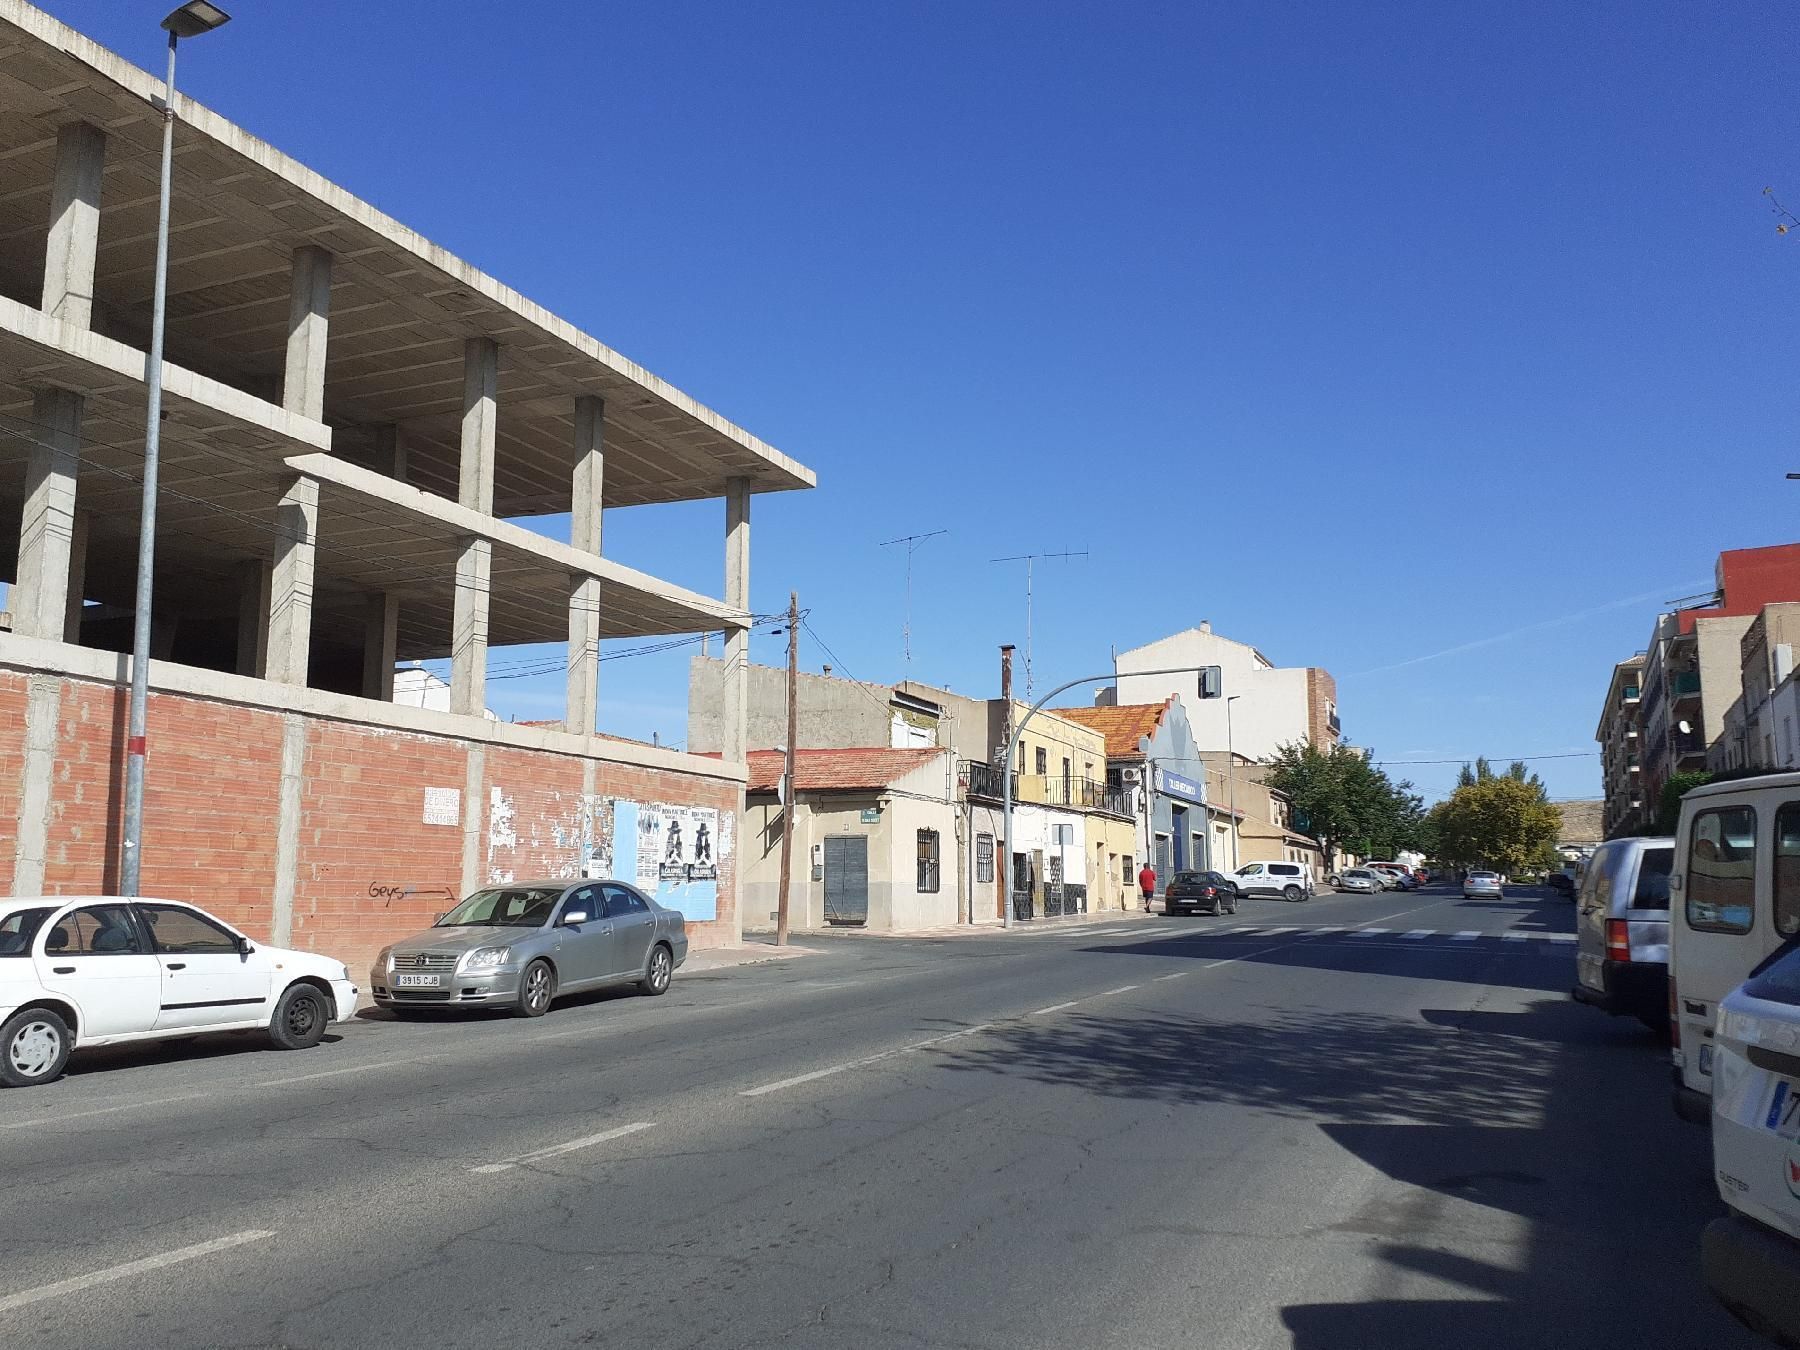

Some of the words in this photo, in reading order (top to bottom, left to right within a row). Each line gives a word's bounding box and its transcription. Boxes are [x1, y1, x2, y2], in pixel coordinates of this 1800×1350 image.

[434, 797, 459, 807] DINERO
[402, 976, 422, 985] 3915
[423, 976, 439, 985] CJB
